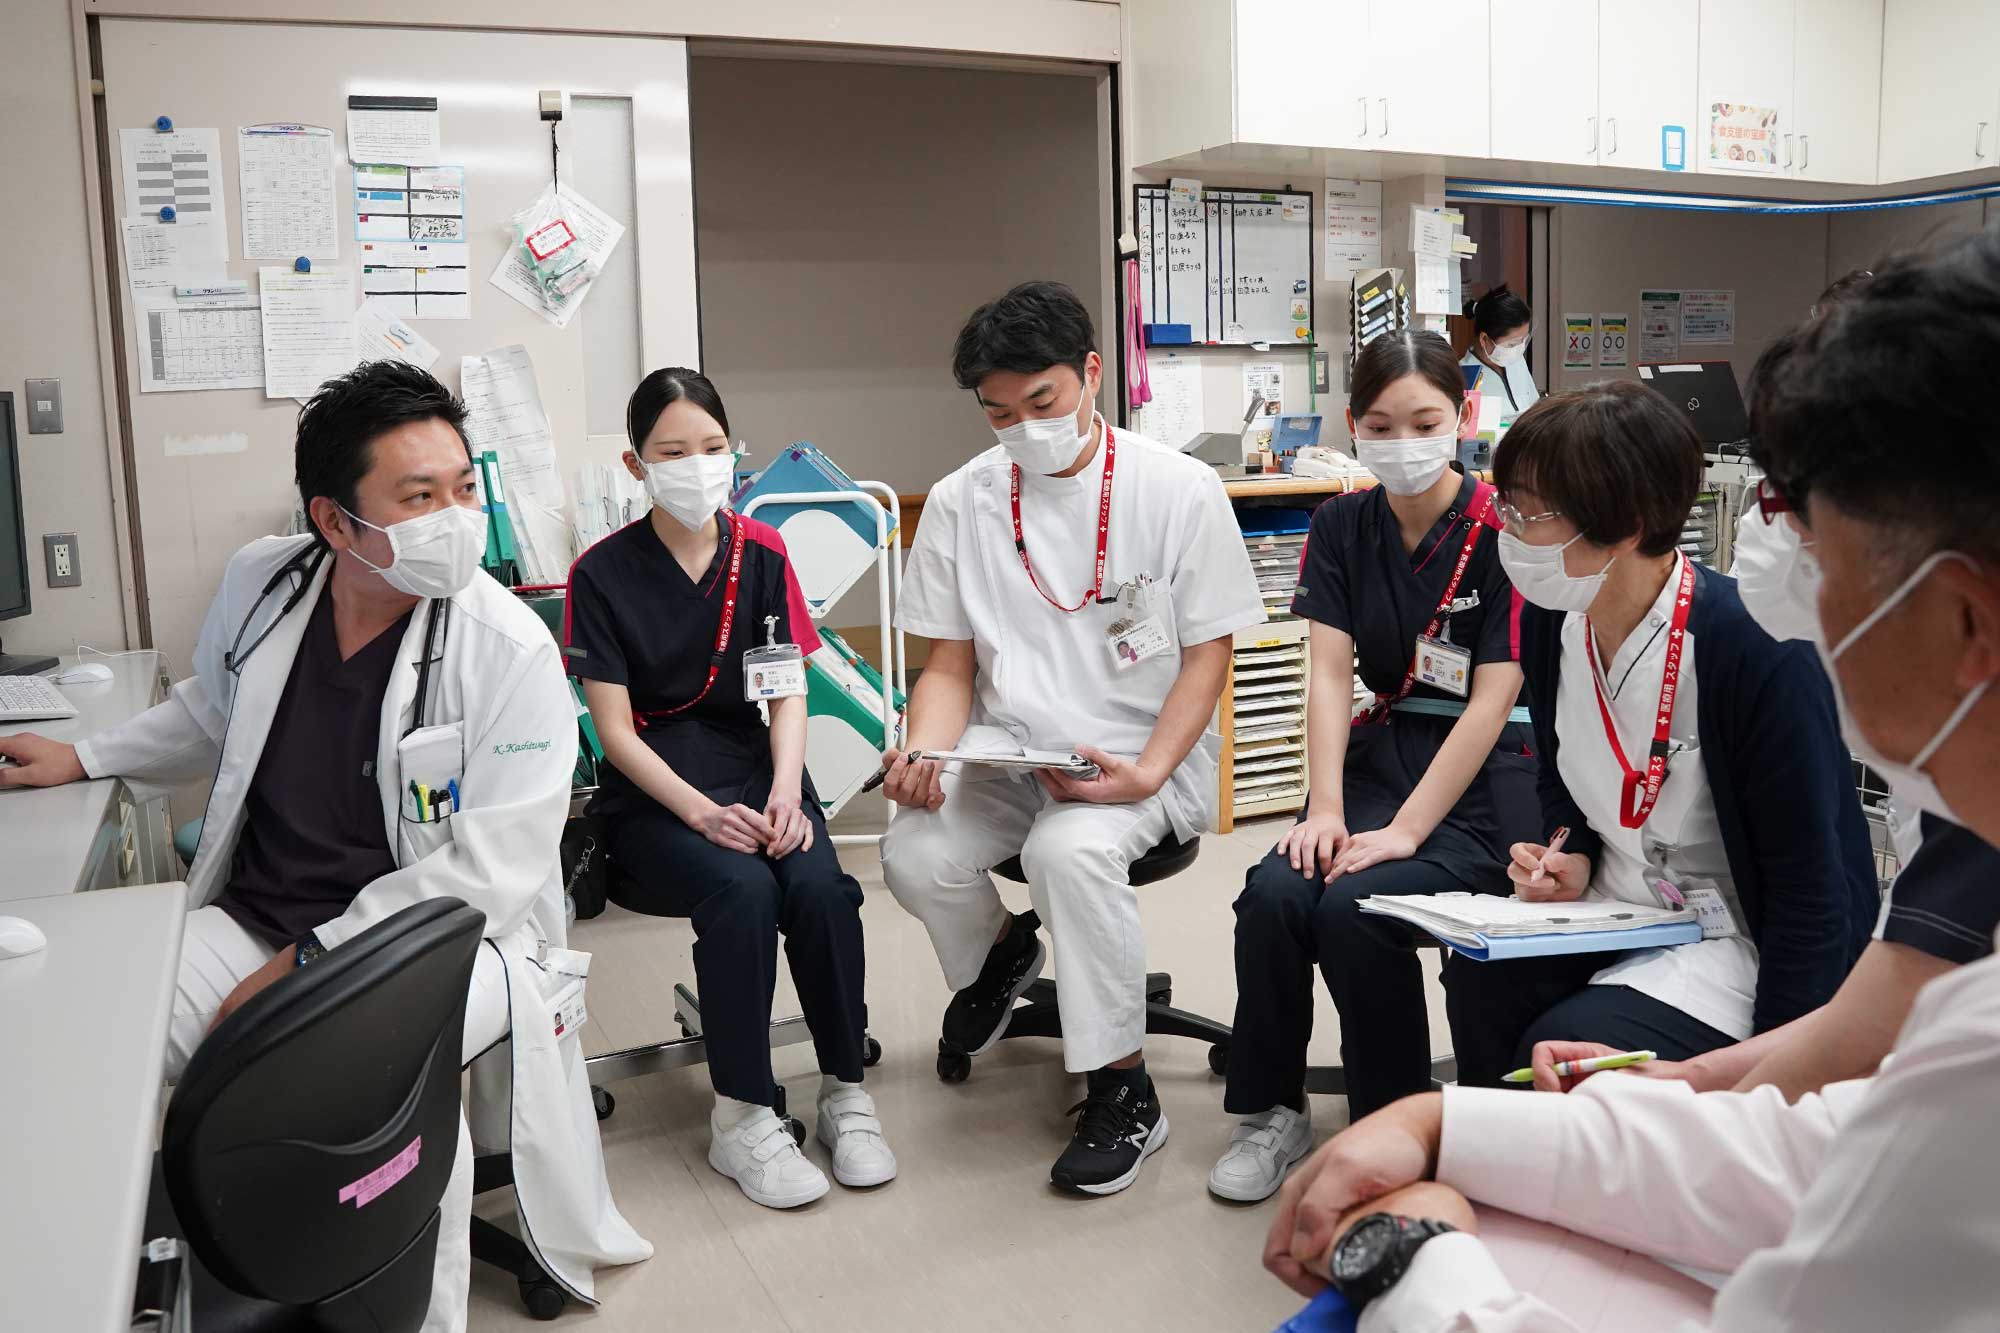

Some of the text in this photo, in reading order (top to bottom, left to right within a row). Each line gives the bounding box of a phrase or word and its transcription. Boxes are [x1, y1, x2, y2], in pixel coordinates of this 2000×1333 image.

[1660, 641, 1681, 714] 医療用スタッフ
